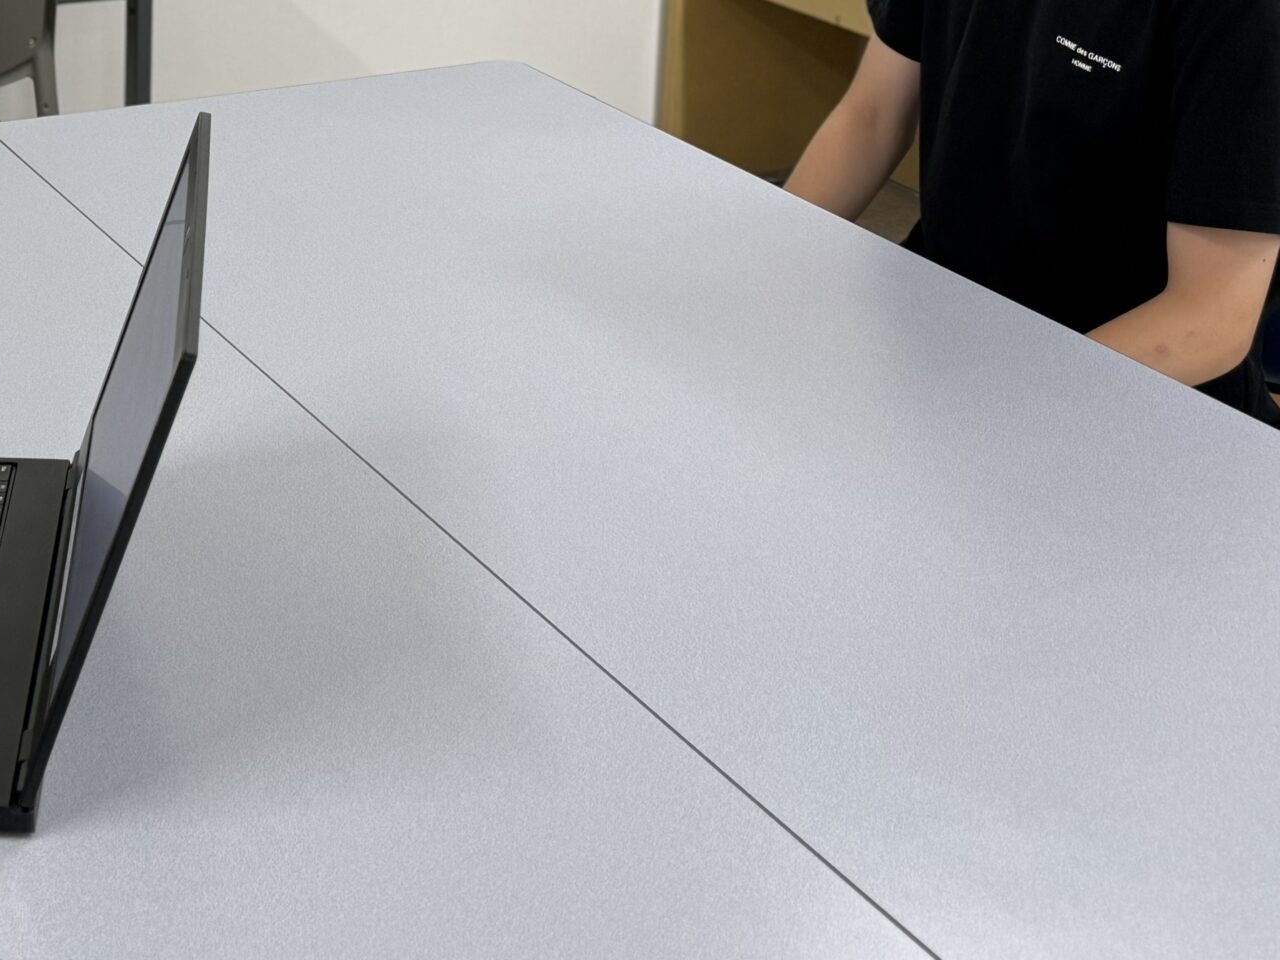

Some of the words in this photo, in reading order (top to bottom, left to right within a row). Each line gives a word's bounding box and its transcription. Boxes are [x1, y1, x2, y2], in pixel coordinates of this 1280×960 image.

[1056, 36, 1077, 51] COMME
[1076, 47, 1088, 57] des
[1087, 52, 1122, 72] GARÇONS
[1071, 58, 1093, 72] HOMME
